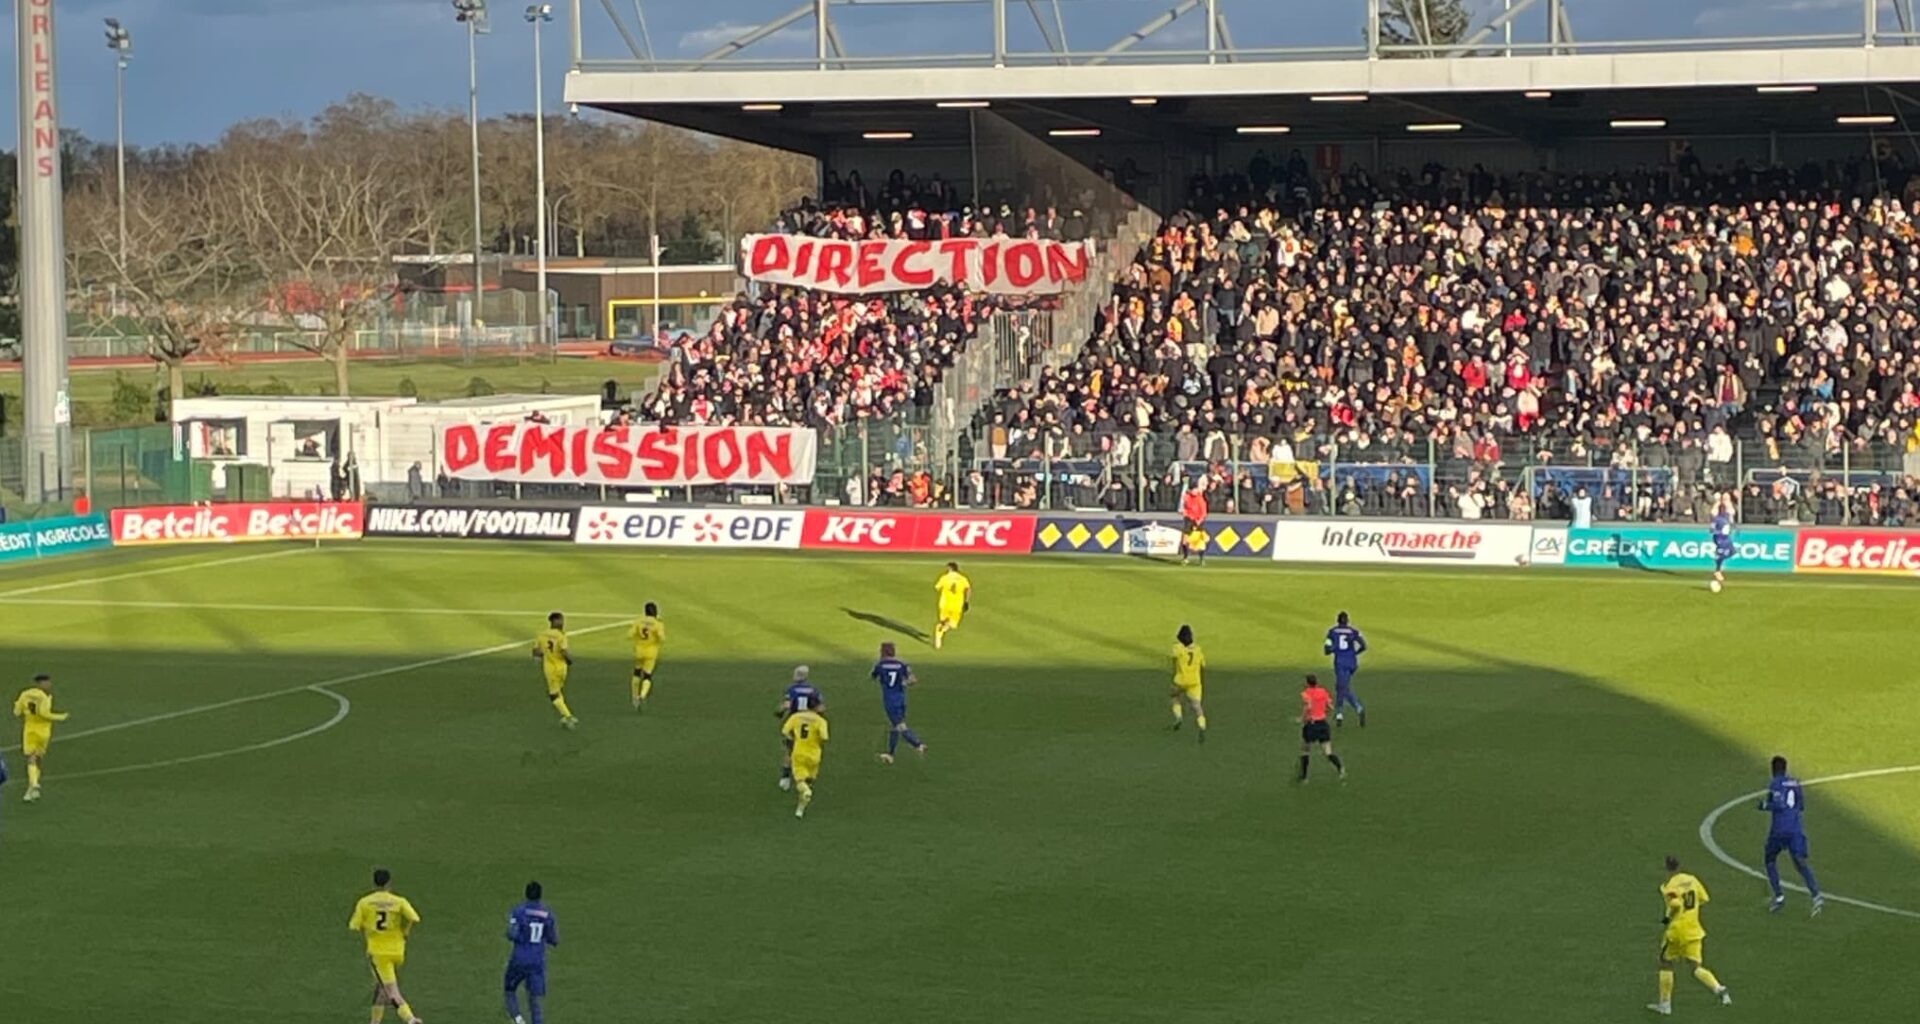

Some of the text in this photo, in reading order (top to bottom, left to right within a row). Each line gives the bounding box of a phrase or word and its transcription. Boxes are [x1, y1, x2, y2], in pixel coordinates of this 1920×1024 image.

[751, 236, 1089, 287] DIRECTION
[445, 424, 793, 480] DEMISSION
[122, 506, 354, 540] Betclic Betclic
[368, 506, 571, 537] NIKE.COM/FOOTBALL
[820, 517, 1011, 547] KFC KFC
[0, 523, 109, 552] ÉDIT AGRICOLE
[1321, 526, 1482, 555] Intermarché
[1662, 540, 1791, 561] AGRCOLE
[1800, 537, 1920, 570] Betclic
[888, 671, 898, 687] 7
[800, 727, 809, 739] 6
[374, 911, 387, 931] 2
